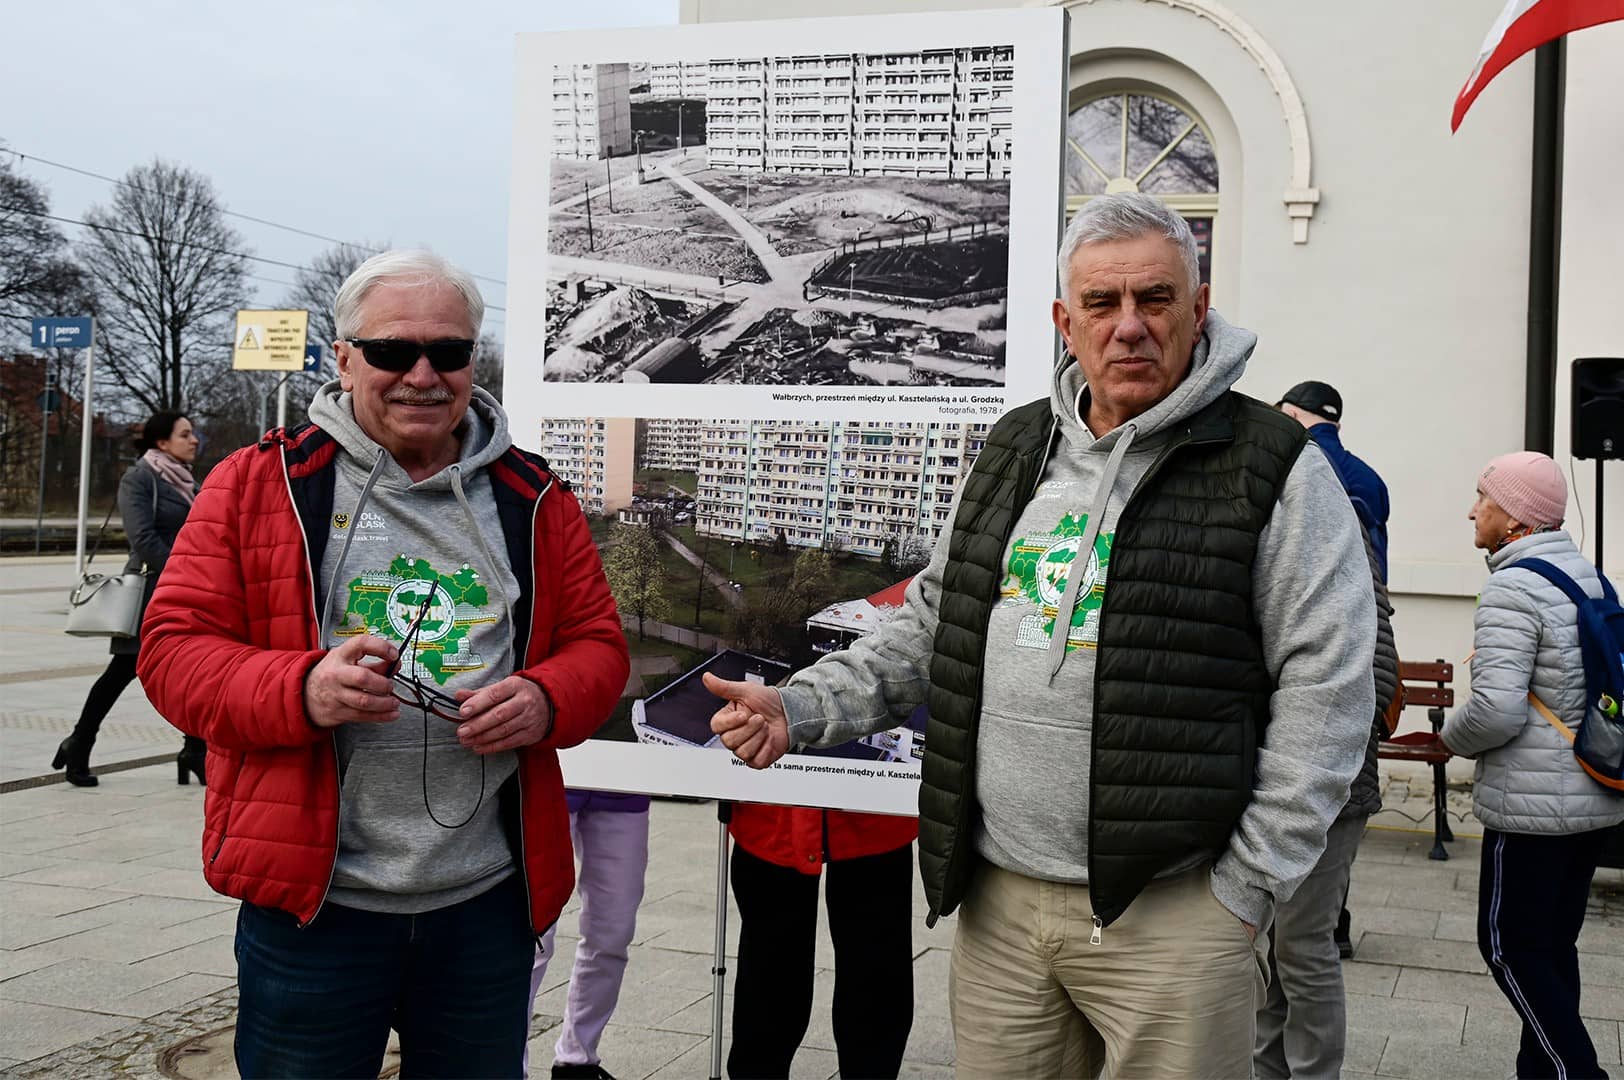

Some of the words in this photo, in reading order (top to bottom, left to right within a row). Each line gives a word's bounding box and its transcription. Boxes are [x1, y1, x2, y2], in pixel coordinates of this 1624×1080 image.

[39, 325, 47, 344] 1
[55, 326, 81, 337] peron
[772, 393, 815, 403] Wałbrzych,
[816, 393, 856, 403] przestrzeń
[857, 394, 886, 404] między
[898, 395, 950, 404] Kasztelańską
[959, 395, 969, 403] ul.
[970, 395, 1004, 405] Grodzką
[939, 406, 978, 416] fotografia,
[980, 407, 998, 415] 1978
[805, 765, 846, 775] przestrzeń
[847, 767, 875, 778] między
